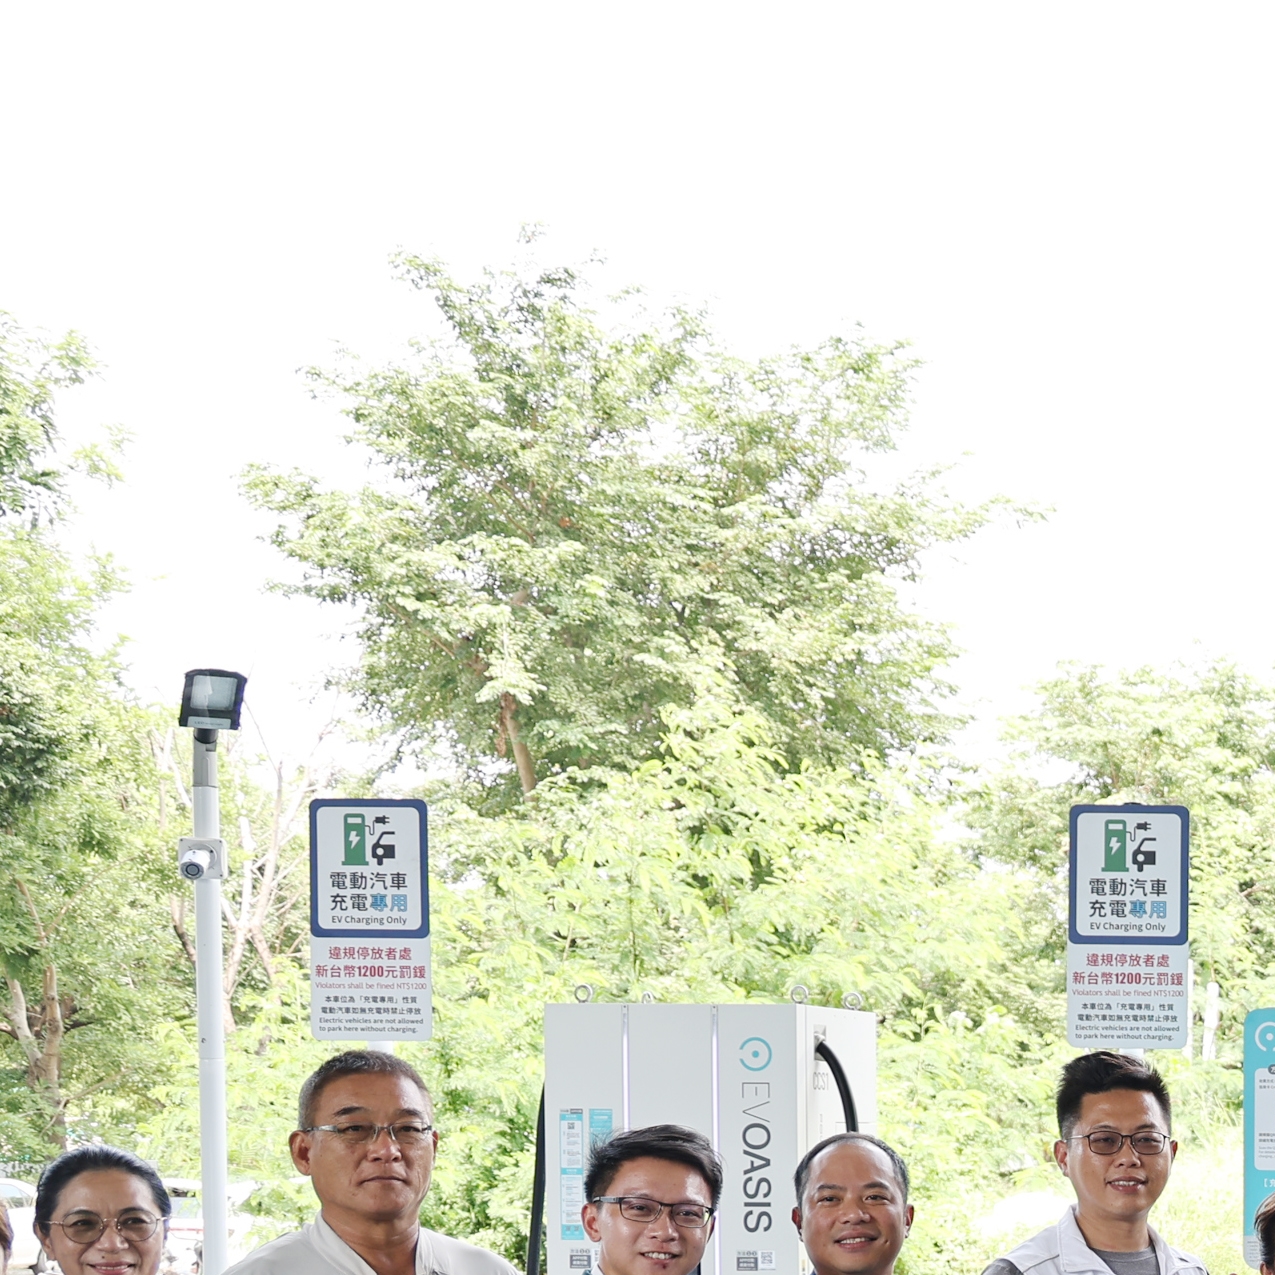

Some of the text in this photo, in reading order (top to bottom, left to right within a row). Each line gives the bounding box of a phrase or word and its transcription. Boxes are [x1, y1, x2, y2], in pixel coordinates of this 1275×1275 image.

[330, 872, 408, 890] 電動汽車
[1089, 878, 1168, 897] 電動汽車
[330, 893, 408, 912] 充電專用
[1088, 899, 1167, 919] 充電專用
[331, 915, 407, 926] EV Charging Only
[1089, 922, 1166, 933] EV Charging Only
[328, 946, 412, 960] 違規停放者處
[1086, 953, 1170, 968] 違規停放者處
[376, 982, 395, 990] fined
[396, 982, 427, 990] NT$1200
[1104, 989, 1121, 997] shall
[1122, 989, 1132, 997] be
[1133, 989, 1152, 997] fined
[1153, 989, 1184, 997] NT$1200
[742, 1082, 773, 1233] EVOASIS
